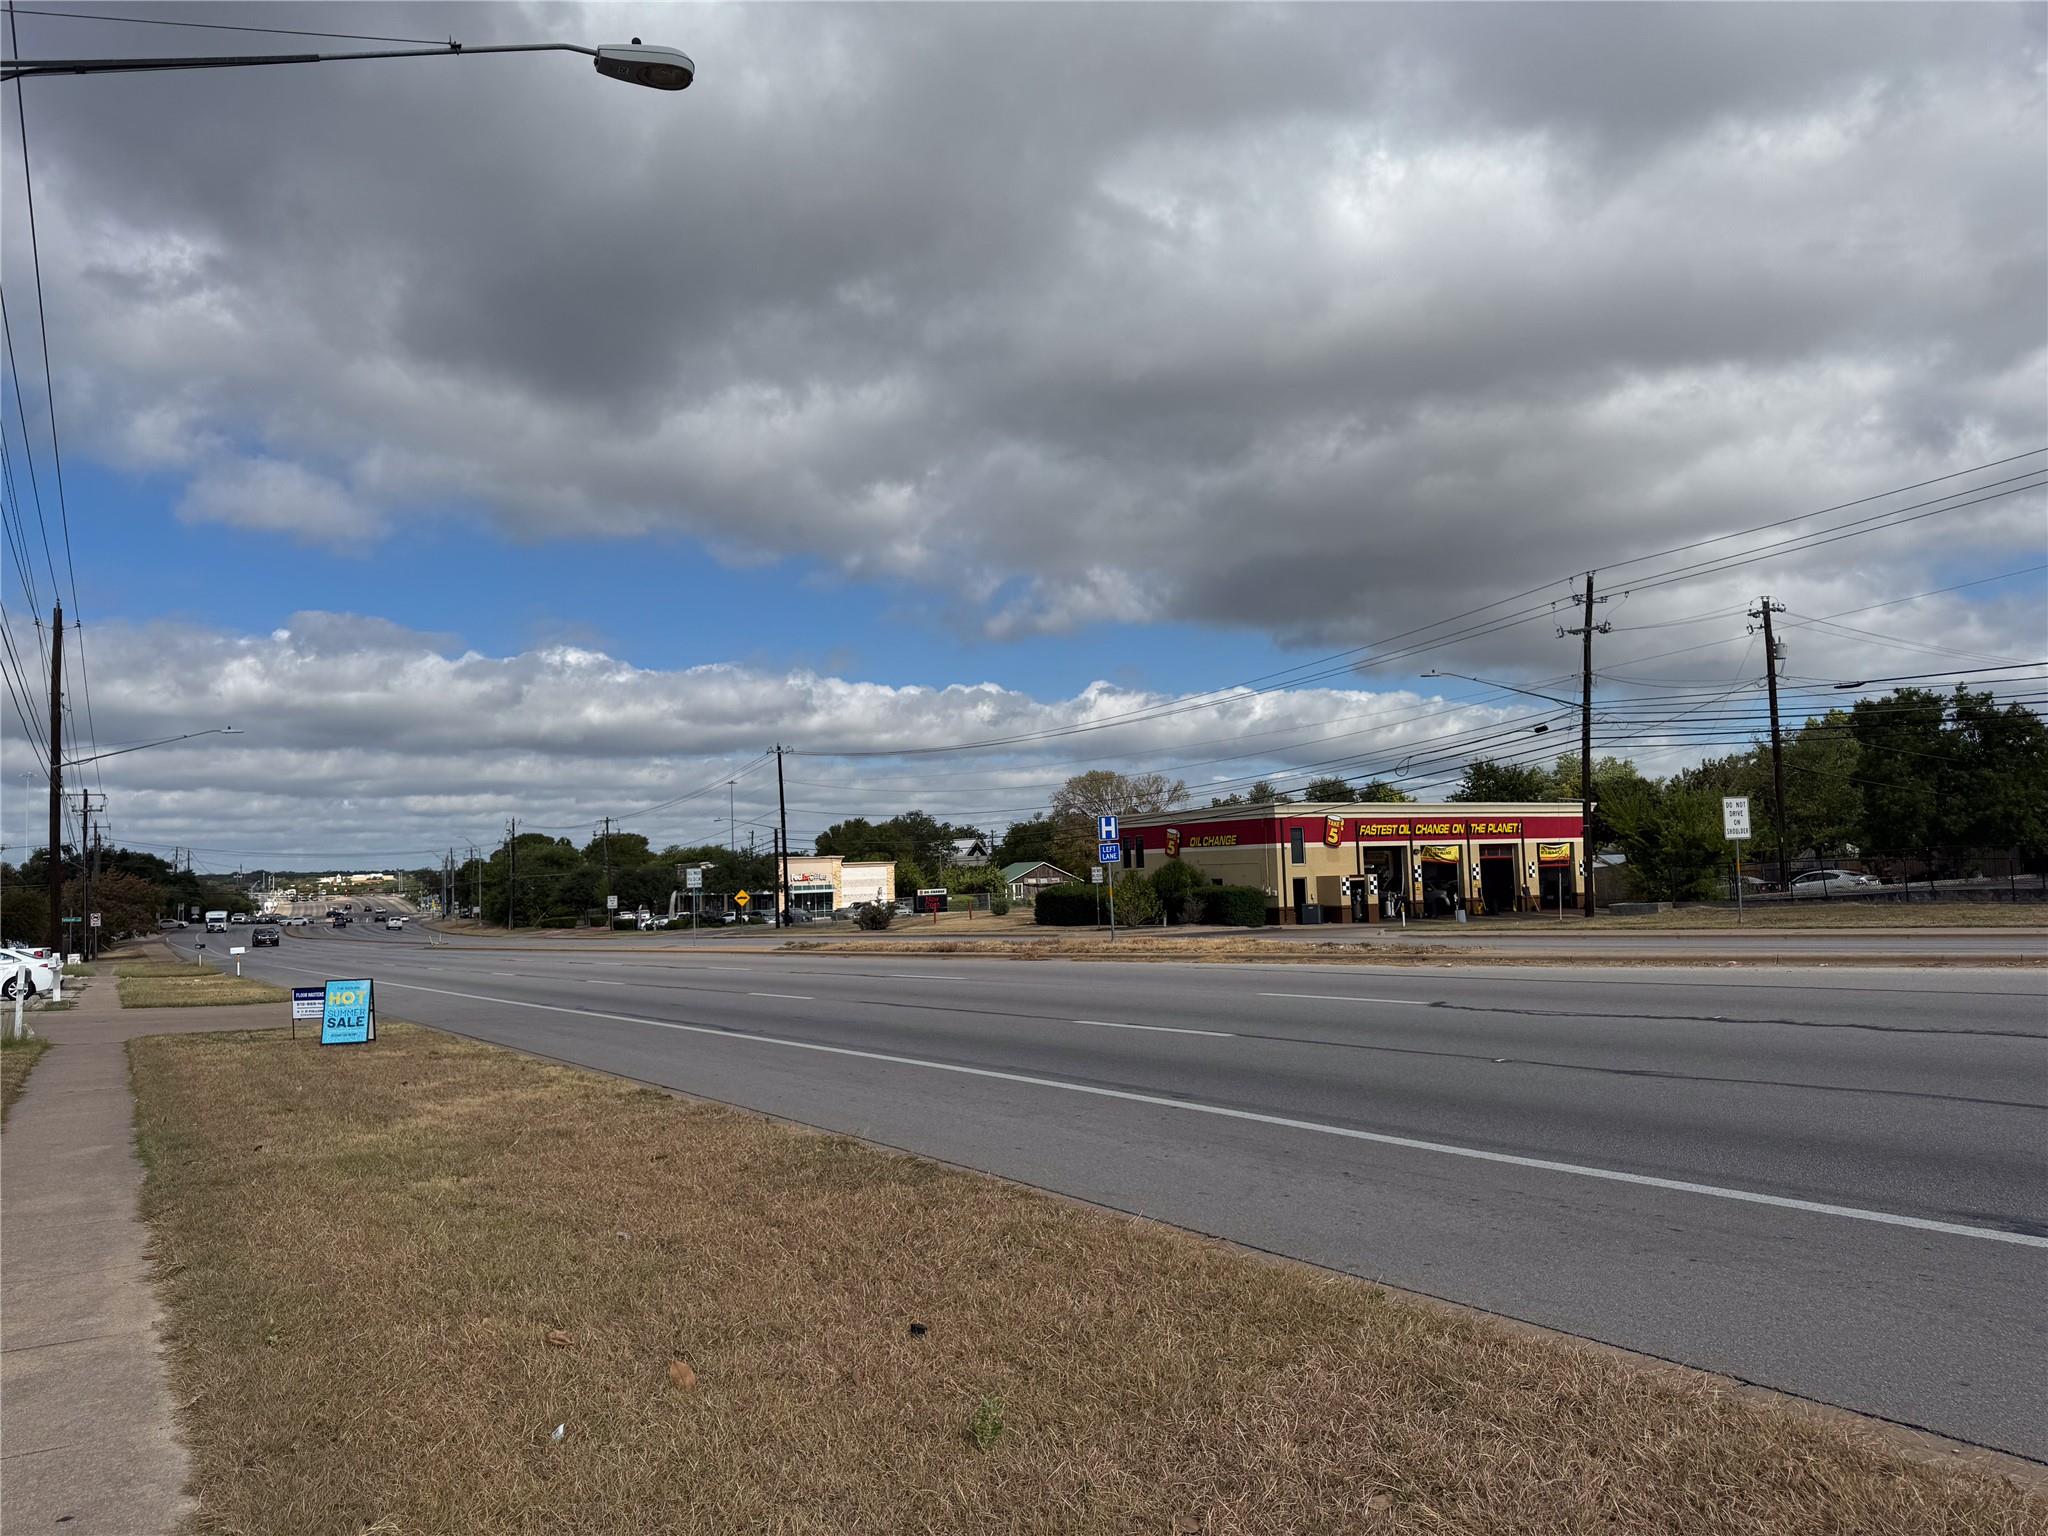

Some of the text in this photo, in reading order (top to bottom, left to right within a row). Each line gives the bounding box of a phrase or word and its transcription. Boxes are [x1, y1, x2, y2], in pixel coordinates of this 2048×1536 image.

[1101, 817, 1116, 839] H
[1359, 824, 1397, 835] FASTEST
[1398, 824, 1411, 835] OIL
[1415, 824, 1449, 834] CHANGE
[1452, 824, 1465, 834] ON
[1471, 823, 1485, 833] THE
[1189, 835, 1237, 847] OIL CHANGE
[1327, 828, 1339, 843] 5
[1167, 841, 1175, 855] 5
[328, 991, 366, 1006] HOT
[327, 1008, 366, 1018] SUMMER
[327, 1016, 365, 1028] SALE
